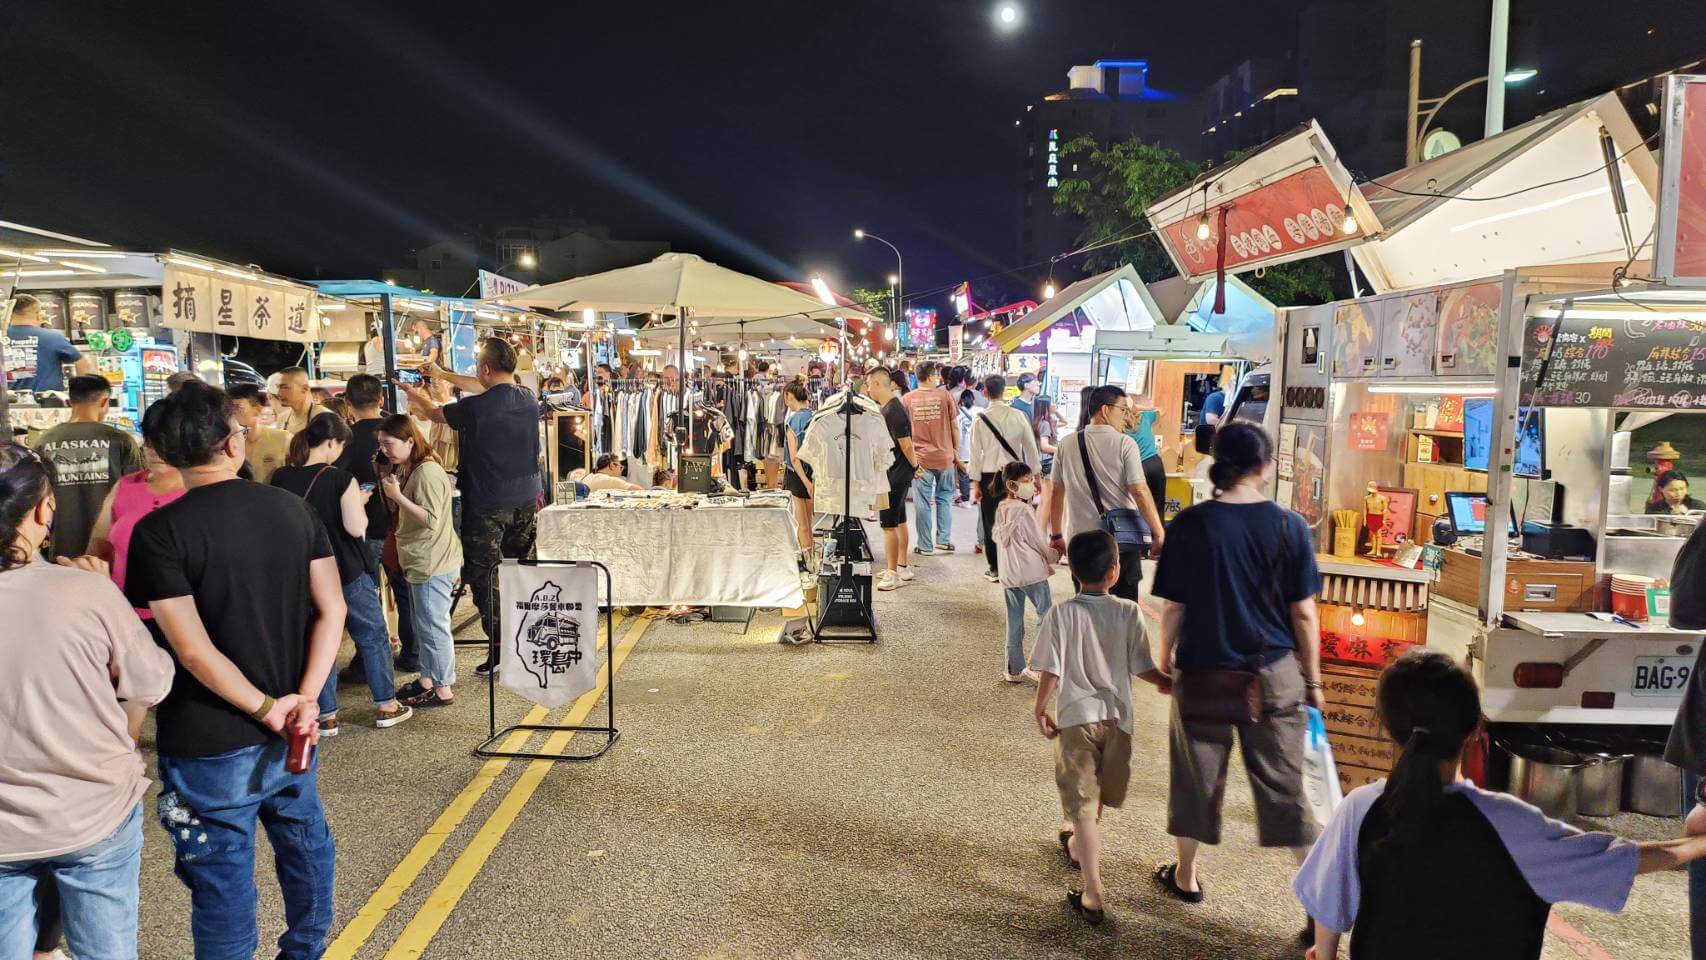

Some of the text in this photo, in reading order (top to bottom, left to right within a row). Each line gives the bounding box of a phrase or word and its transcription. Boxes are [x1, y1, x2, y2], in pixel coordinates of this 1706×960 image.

[172, 281, 307, 334] 摘星茶道
[1574, 391, 1591, 404] 30
[44, 439, 110, 451] ALASKAN
[57, 471, 109, 482] UNTAINS
